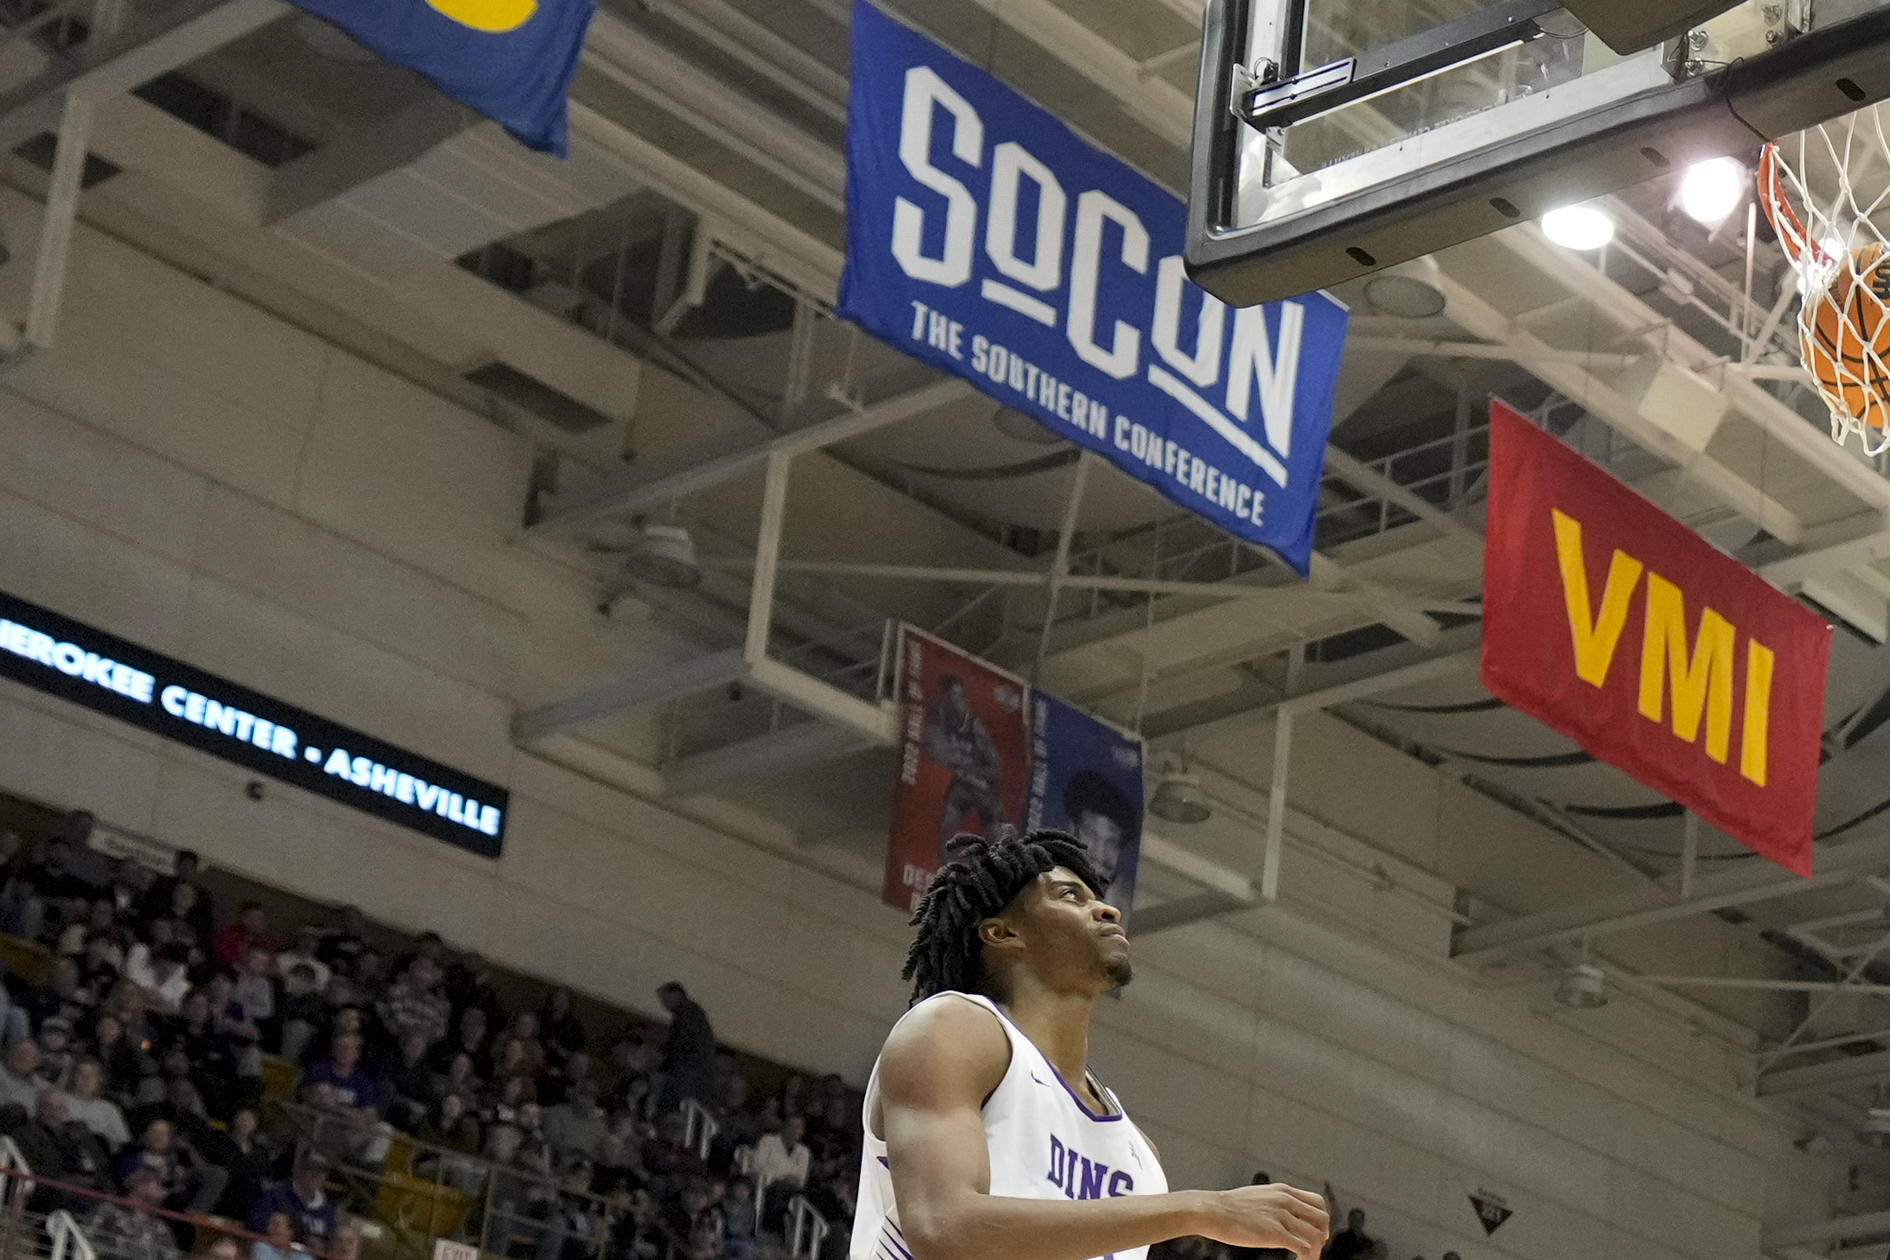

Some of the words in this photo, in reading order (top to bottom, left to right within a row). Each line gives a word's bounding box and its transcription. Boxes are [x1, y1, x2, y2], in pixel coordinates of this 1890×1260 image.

[910, 300, 964, 362] THE
[971, 334, 1107, 441] SOUTHERN
[1114, 414, 1265, 528] CONFERENCE
[160, 685, 299, 760] CENTER
[323, 747, 500, 837] ASHEVILLE
[1551, 508, 1775, 788] VMI
